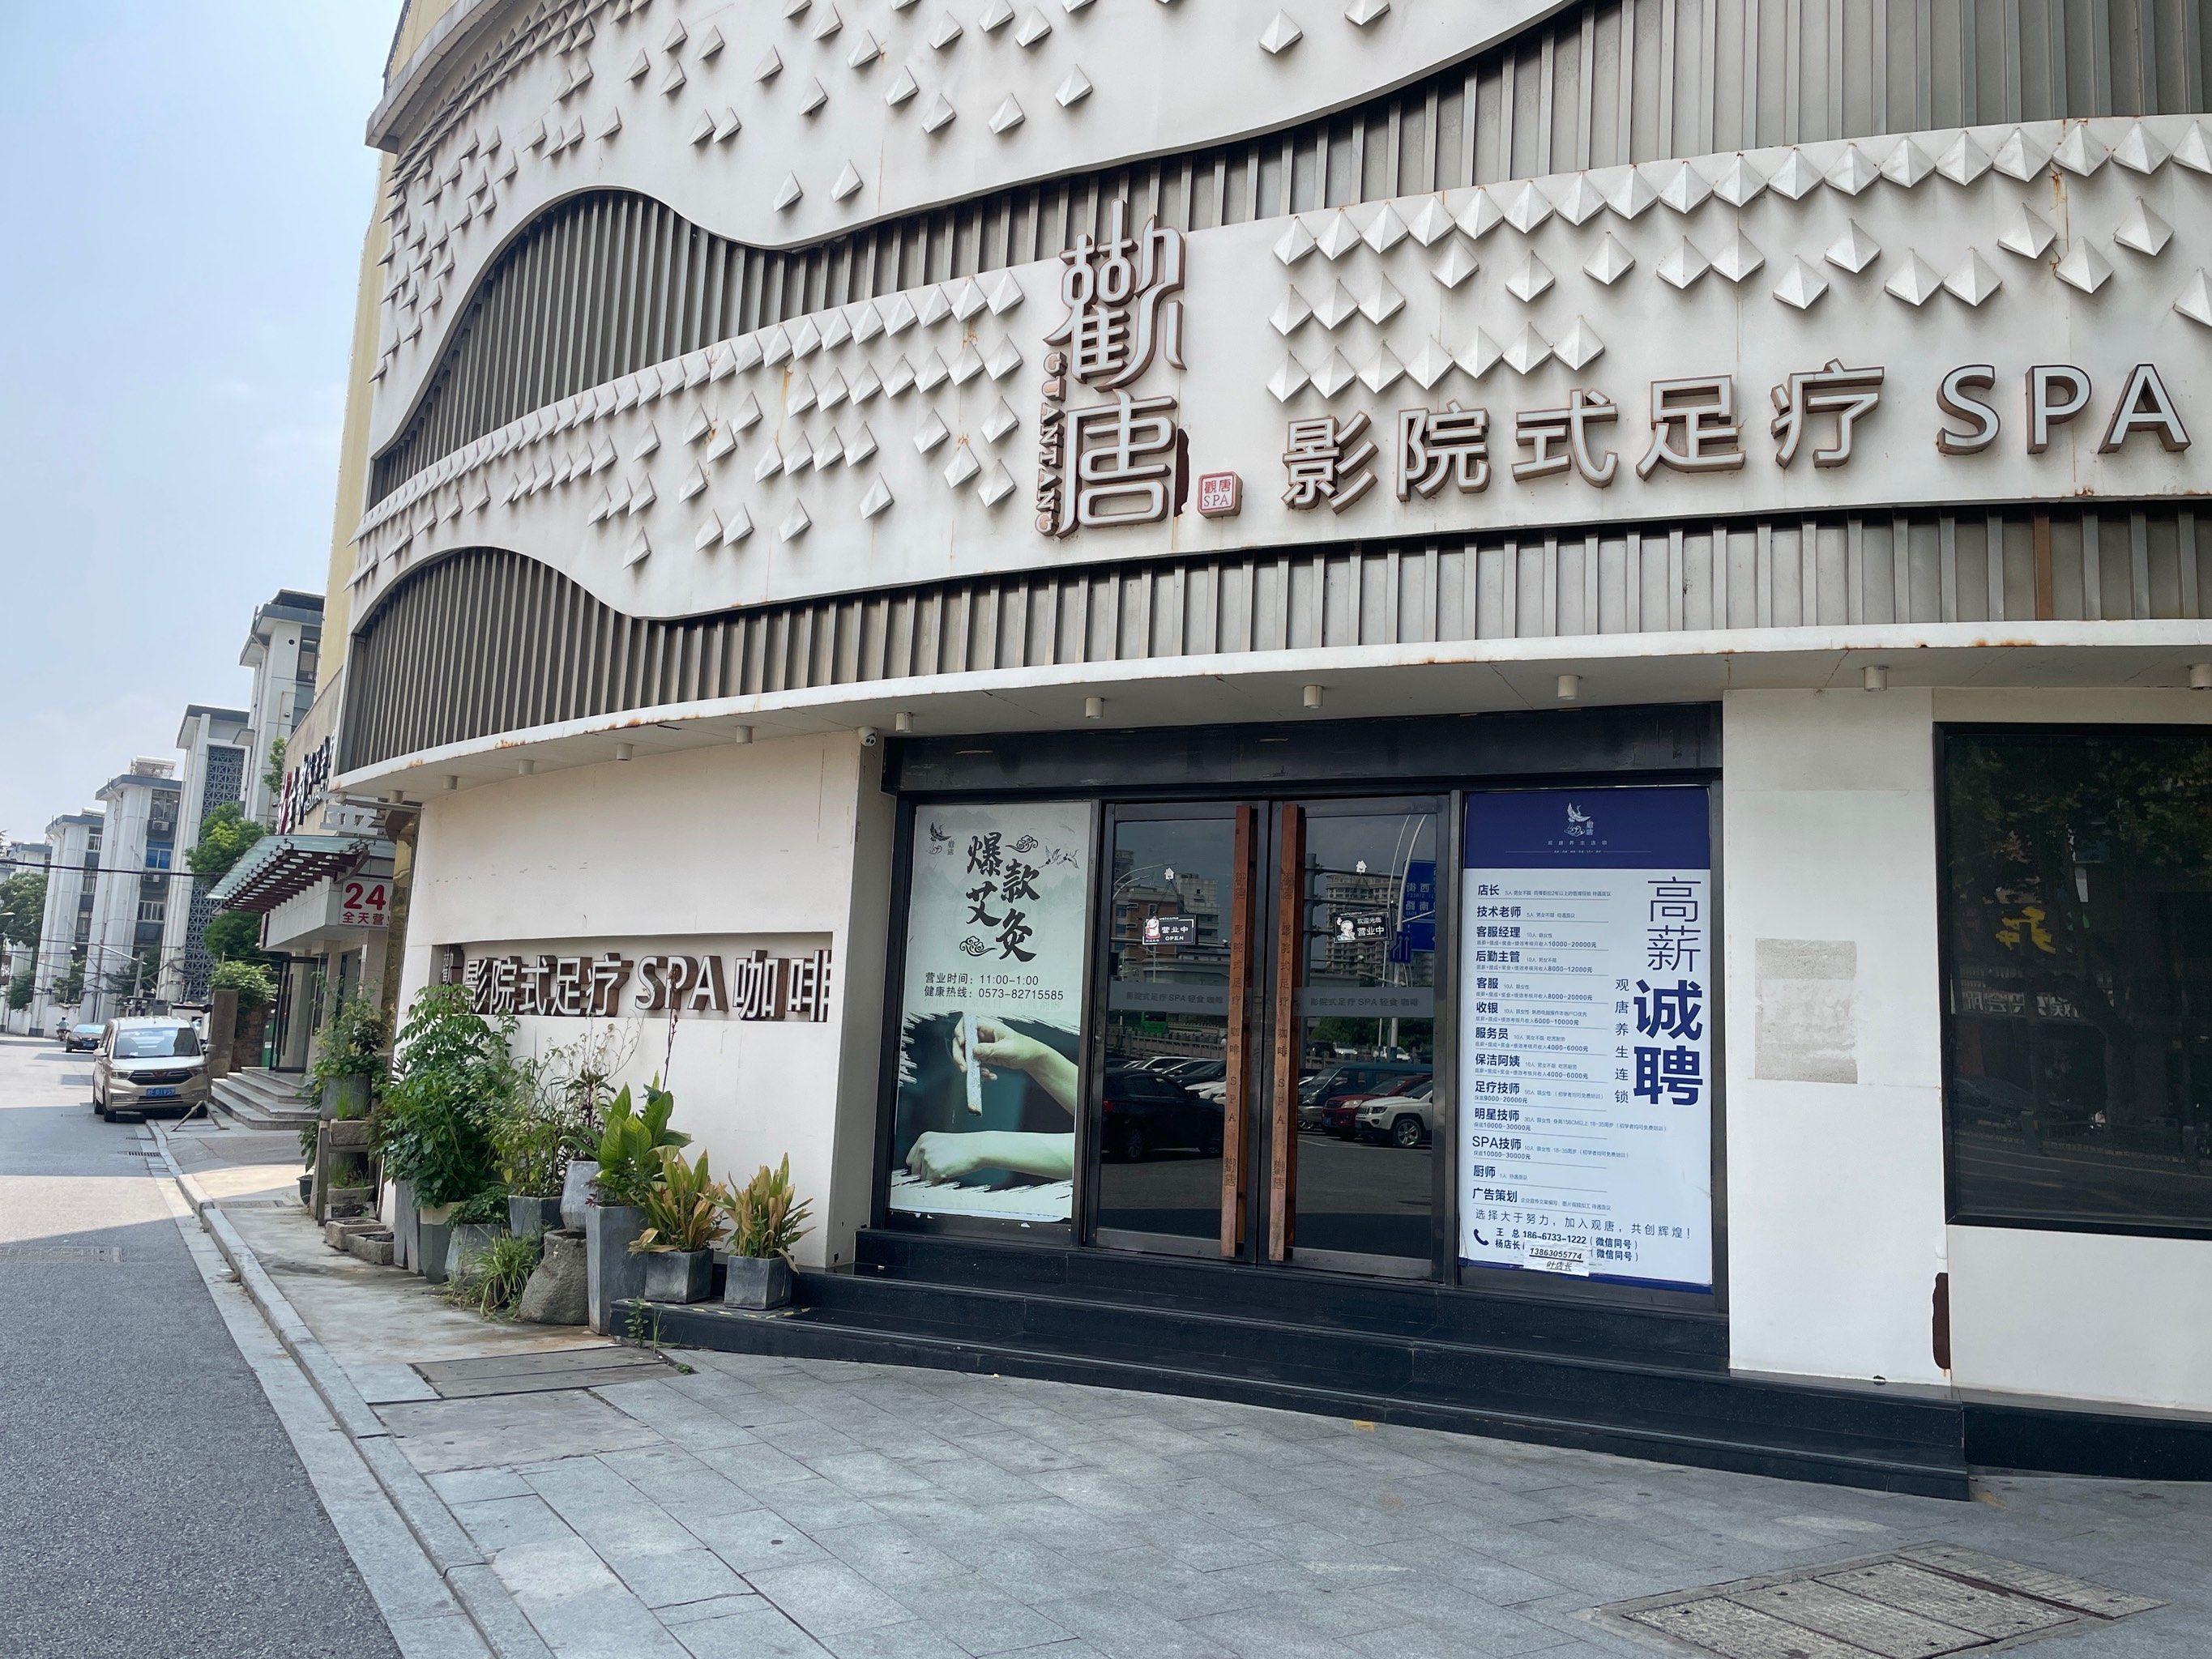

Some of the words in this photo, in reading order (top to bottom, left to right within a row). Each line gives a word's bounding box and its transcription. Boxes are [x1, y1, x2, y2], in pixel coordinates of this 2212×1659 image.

[1281, 358, 1885, 514] 影院式足疗
[1937, 363, 2192, 455] SPA
[1035, 351, 1067, 536] GUANTANG
[1204, 494, 1229, 507] SPA
[344, 882, 392, 911] 24
[1478, 884, 1500, 896] 店长
[343, 911, 390, 926] 全天营
[1476, 906, 1521, 918] 技术老师
[1161, 925, 1189, 934] 营业中
[1357, 926, 1385, 936] 营业中
[1476, 926, 1521, 938] 客服经理
[1475, 950, 1520, 962] 后勤主管
[634, 954, 728, 1013] SPA
[733, 949, 832, 1022] 咖啡
[1476, 977, 1499, 989] 客服
[1168, 994, 1185, 1002] SPA
[1475, 1002, 1498, 1014] 收银
[1475, 1026, 1509, 1040] 服务员
[1615, 979, 1629, 1103] 观唐养生连锁
[1475, 1053, 1520, 1068] 保洁阿姨
[1475, 1081, 1520, 1094] 足疗技师
[1228, 1077, 1237, 1122] SPA
[1276, 1078, 1285, 1124] SPA
[1474, 1107, 1519, 1122] 明星技师
[1471, 1136, 1522, 1150] SPA技师
[1473, 1165, 1496, 1179] 厨师
[1472, 1188, 1518, 1203] 广告策划
[1495, 1239, 1520, 1250] 杨店长
